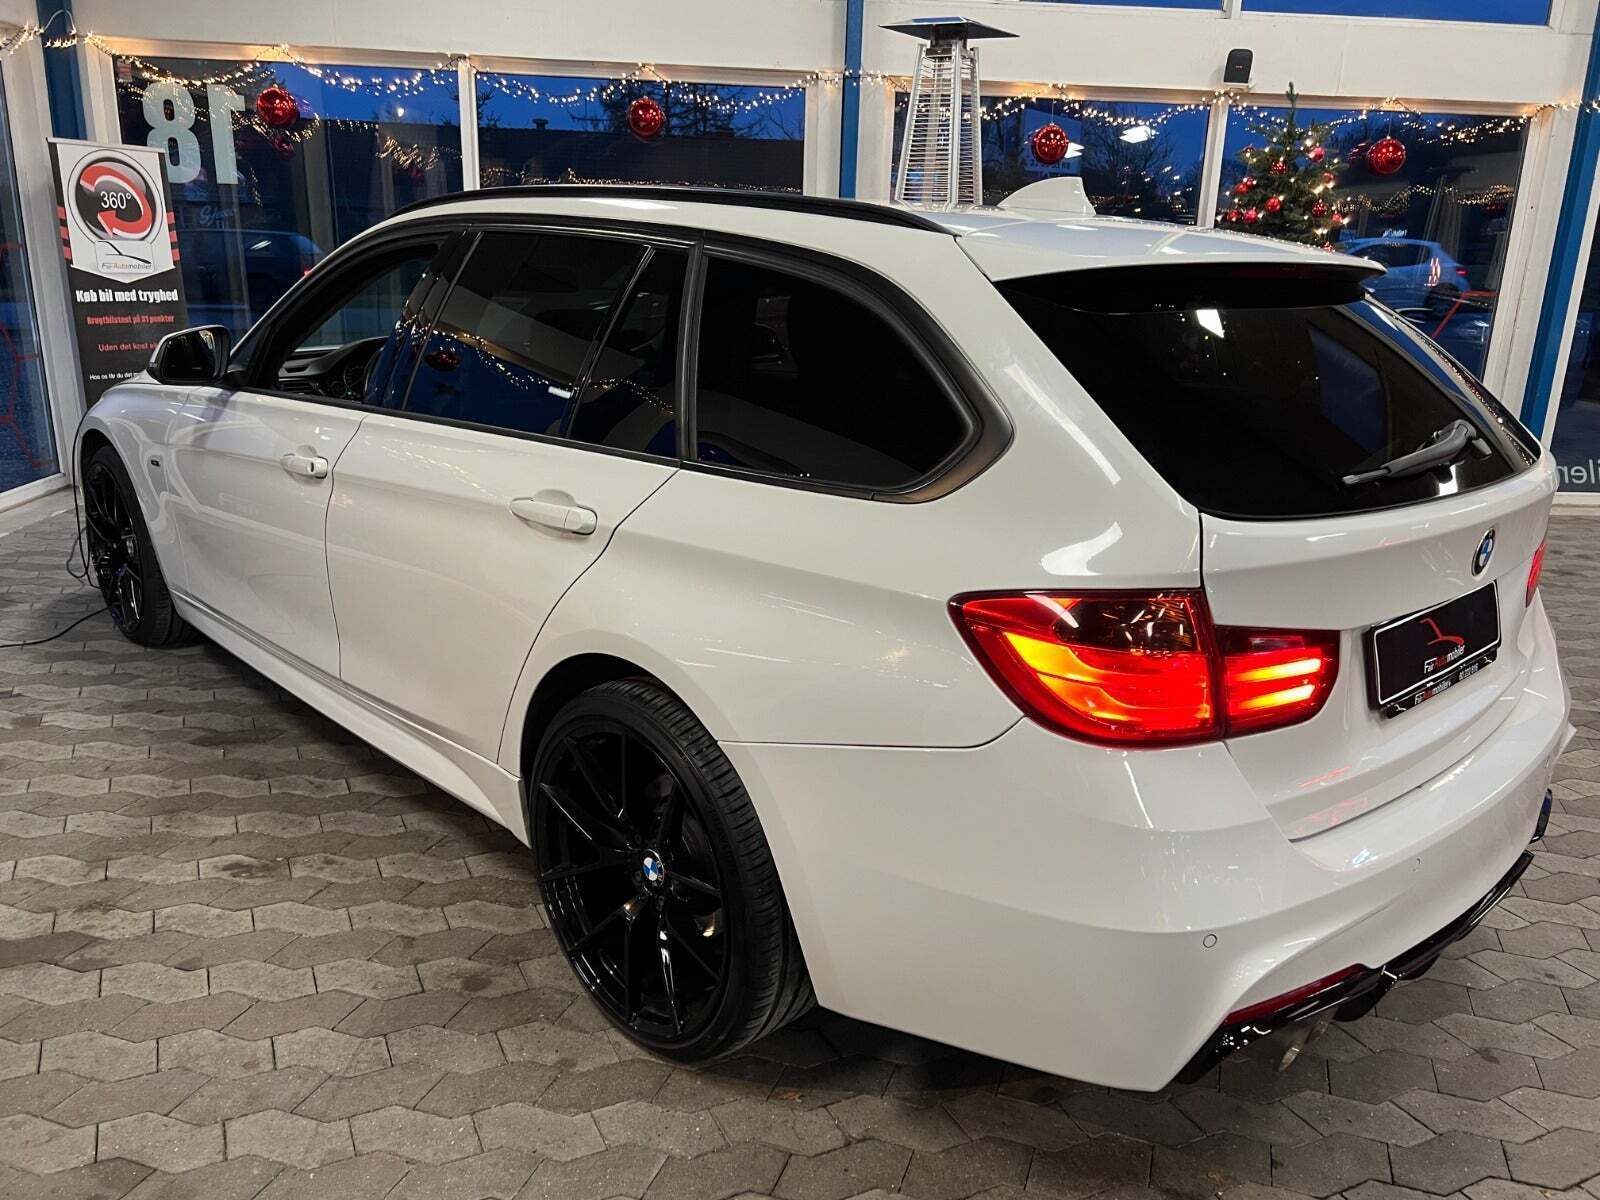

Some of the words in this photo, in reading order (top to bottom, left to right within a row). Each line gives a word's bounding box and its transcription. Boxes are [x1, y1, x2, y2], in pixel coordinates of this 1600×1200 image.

[100, 190, 132, 209] 360°
[75, 290, 97, 303] Køb
[98, 289, 113, 302] bil
[115, 289, 137, 302] med
[138, 289, 178, 303] tryghed
[150, 314, 174, 324] punkter
[98, 343, 119, 352] Uden
[120, 343, 132, 351] det
[133, 343, 148, 351] kost
